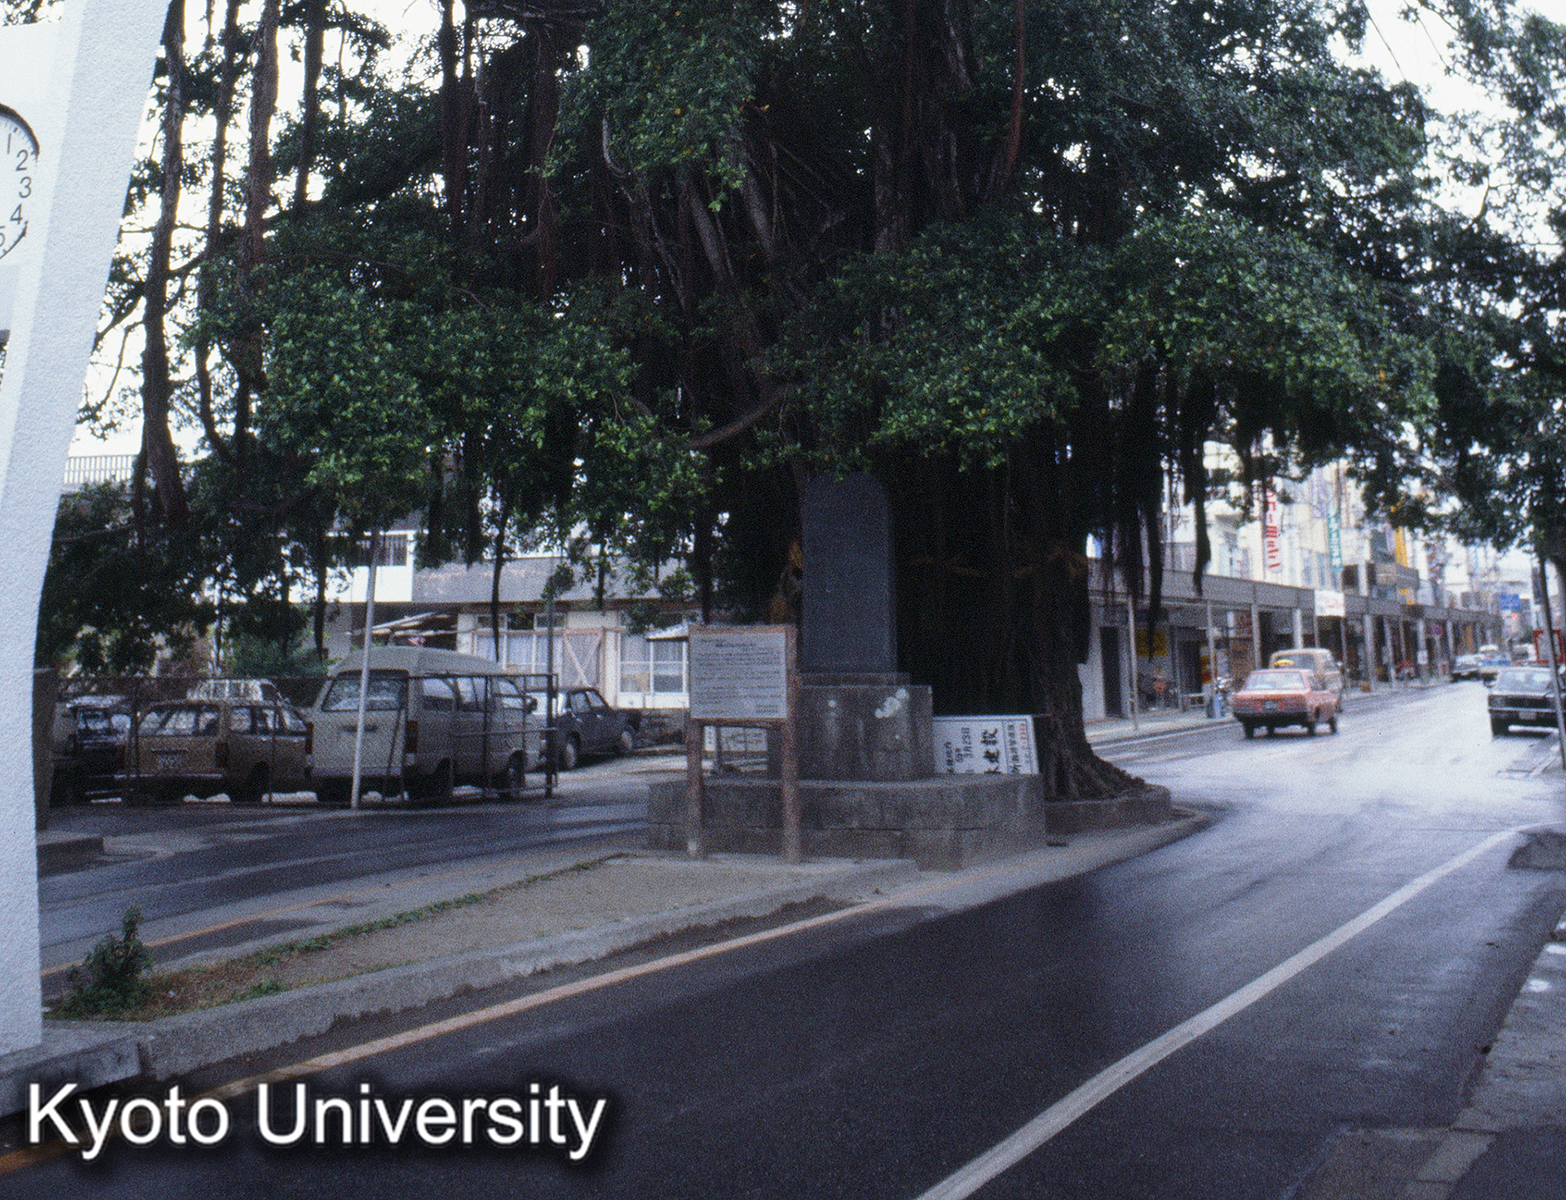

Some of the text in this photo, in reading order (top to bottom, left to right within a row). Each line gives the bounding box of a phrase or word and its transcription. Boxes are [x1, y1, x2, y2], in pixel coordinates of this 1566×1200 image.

[15, 149, 29, 171] 2
[18, 176, 32, 198] 3
[10, 203, 24, 225] 4
